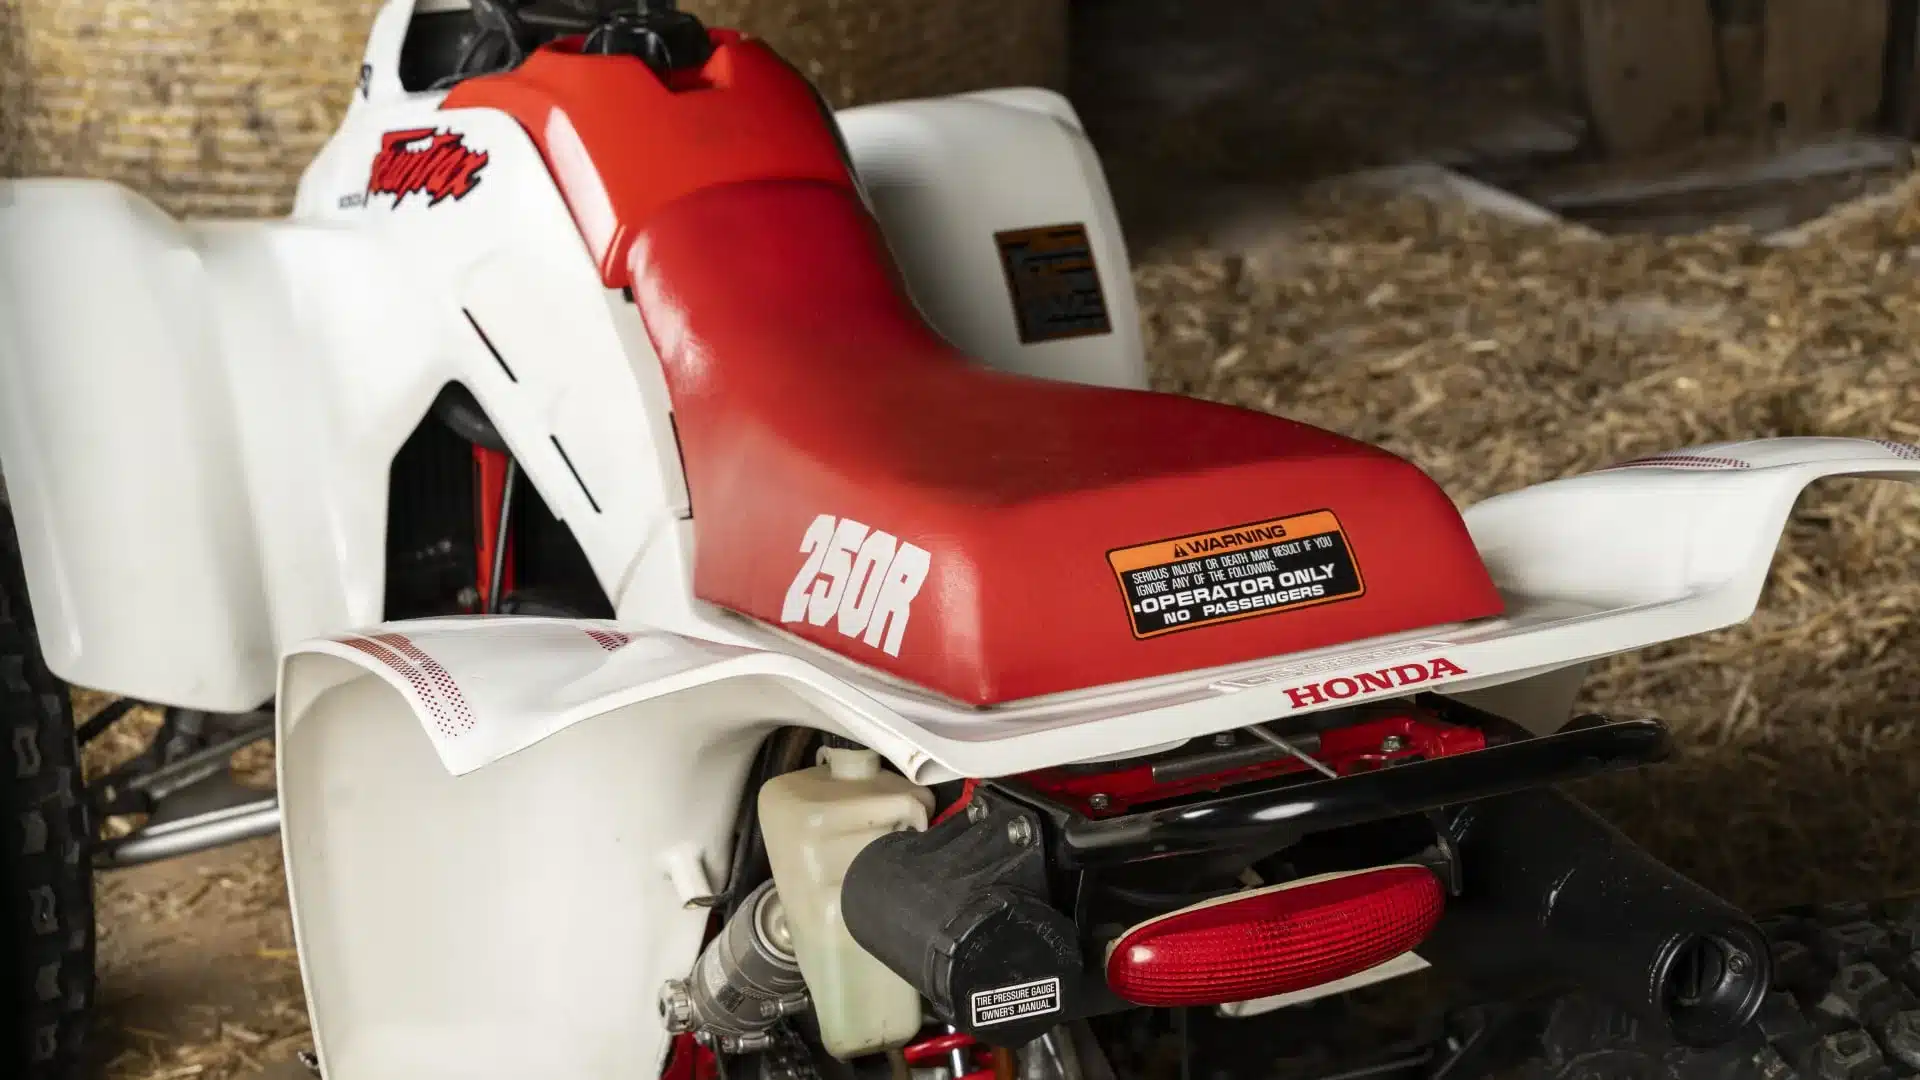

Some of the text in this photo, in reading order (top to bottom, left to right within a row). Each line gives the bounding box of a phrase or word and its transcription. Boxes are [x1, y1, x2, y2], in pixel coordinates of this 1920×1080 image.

[1185, 525, 1287, 554] WARNING
[1132, 535, 1333, 585] SERIOUS INJURY OR DEATH MAY RESULT IF YOU
[1135, 560, 1279, 597] IGNORE ANY OF THE FOLLOWING.
[1278, 562, 1335, 587] ONLY
[780, 514, 932, 658] 250R
[1163, 584, 1325, 625] NO PASSENGERS
[1282, 657, 1468, 709] HONDA
[976, 982, 1056, 1007] TIRE PRESSURE GAUGE
[981, 998, 1051, 1021] OWNER'S MANUAL
